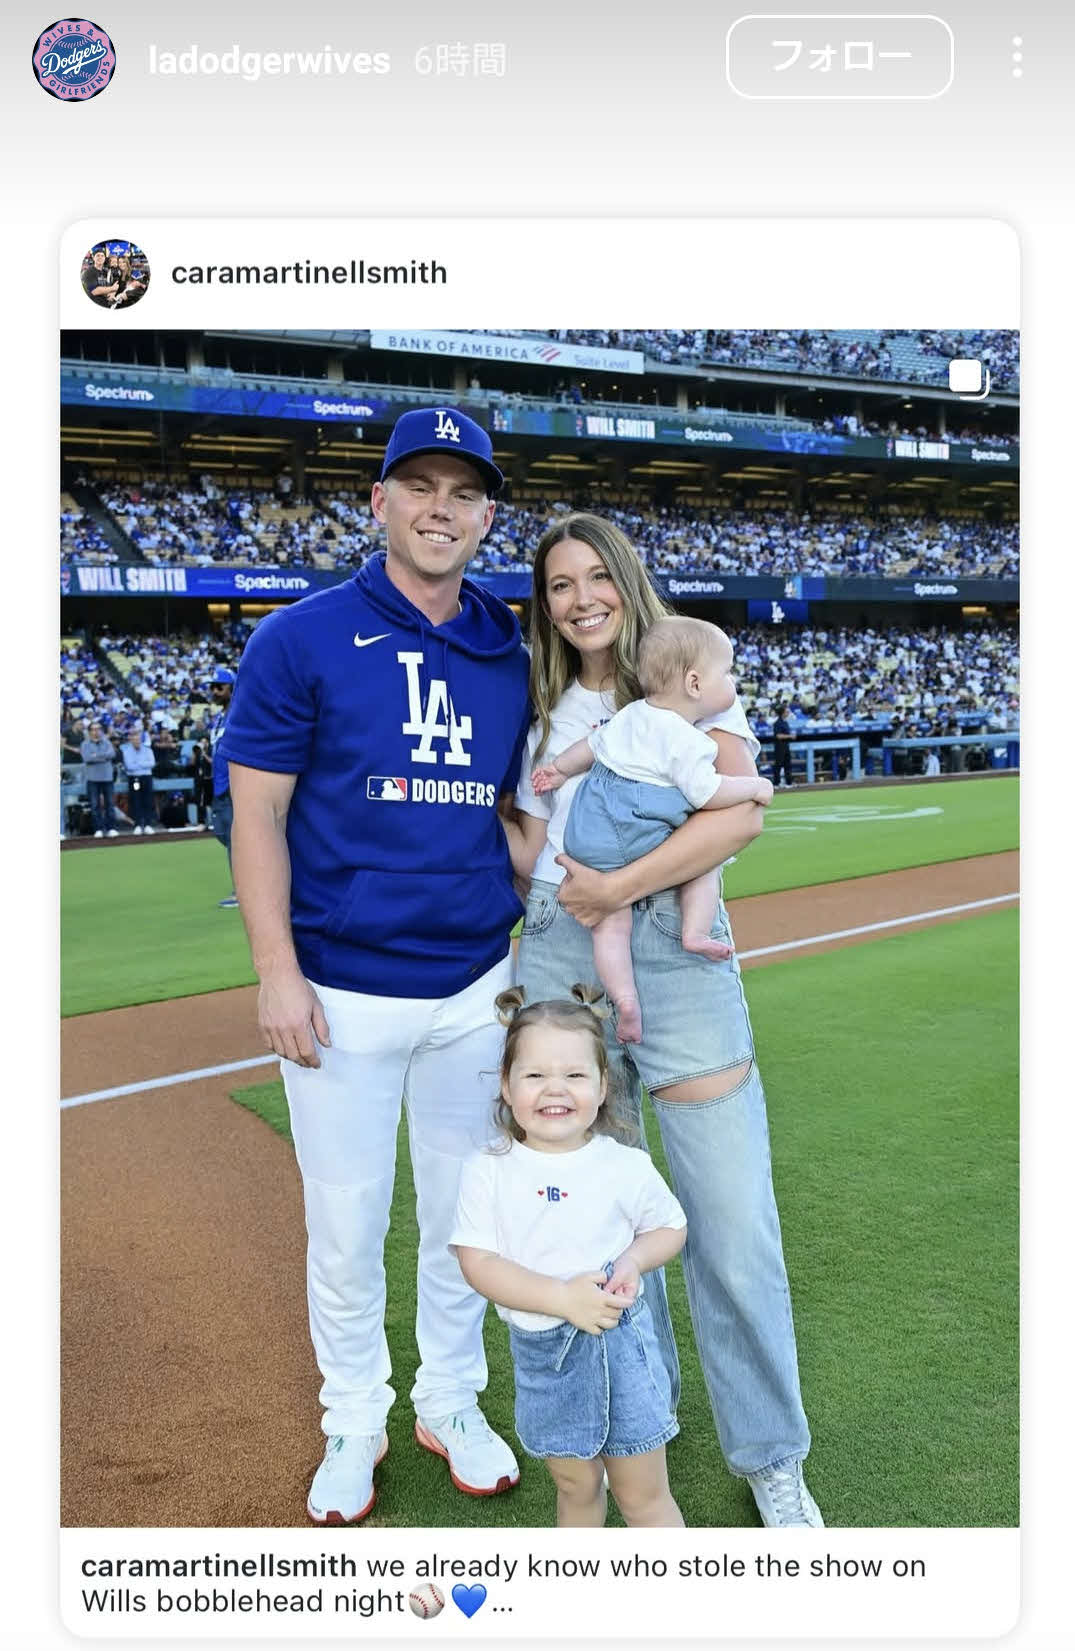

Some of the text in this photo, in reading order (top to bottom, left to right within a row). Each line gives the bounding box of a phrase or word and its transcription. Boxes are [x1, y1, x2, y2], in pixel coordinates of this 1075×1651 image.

[388, 336, 529, 360] BANK OF AMERICA
[84, 383, 150, 402] Spectrum
[313, 400, 370, 417] Spectrum
[434, 411, 460, 442] LA
[586, 416, 656, 439] WILL SMITH
[684, 427, 730, 442] Spectrum
[77, 568, 187, 592] WILL SMITH
[234, 574, 306, 591] Spectrum
[668, 579, 721, 595] Spectrum
[913, 583, 956, 597] Spectrum
[397, 651, 473, 766] LA
[412, 778, 496, 808] DODGERS
[547, 1186, 560, 1202] 16
